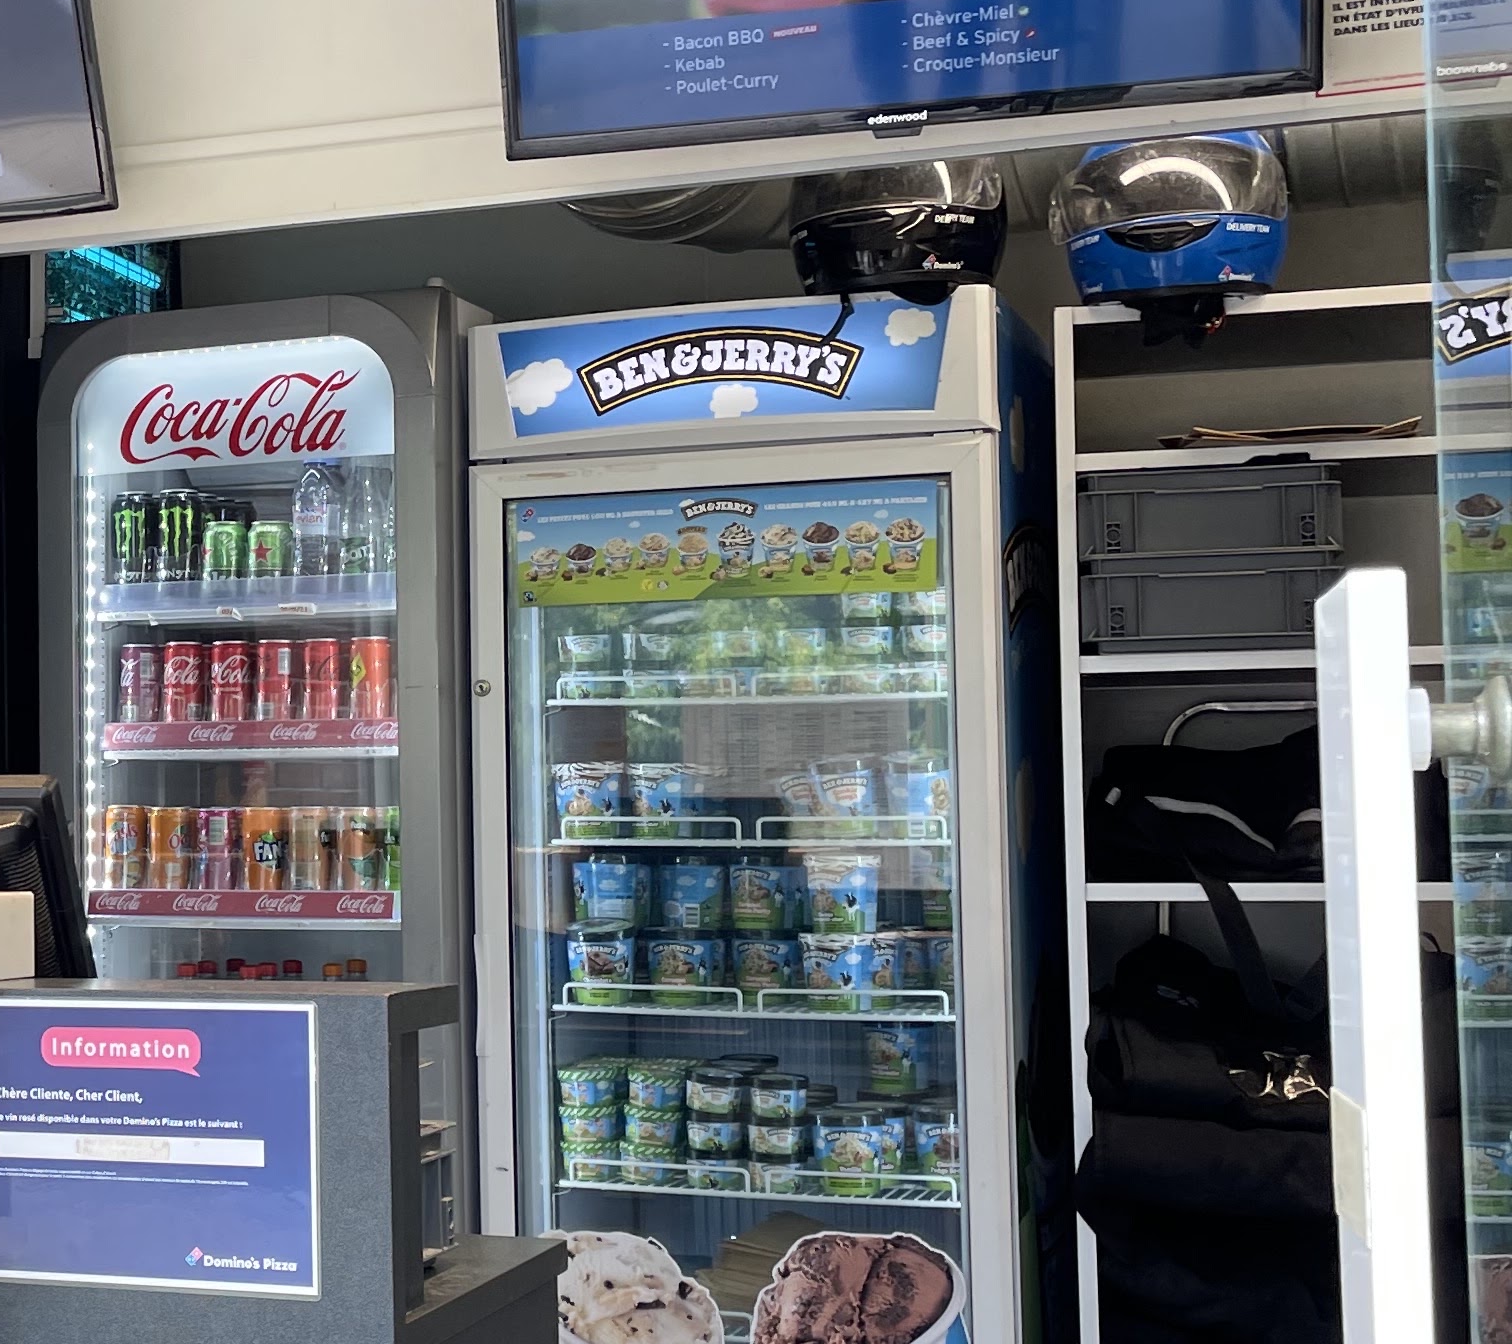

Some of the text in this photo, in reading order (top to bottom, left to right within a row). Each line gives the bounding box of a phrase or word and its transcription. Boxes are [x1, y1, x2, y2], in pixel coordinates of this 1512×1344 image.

[1346, 0, 1367, 10] EST
[912, 4, 1014, 29] Chèvre-Miel
[1333, 10, 1382, 24] EN ÉTAT
[1333, 22, 1390, 36] DANS LES
[674, 33, 724, 51] Bacon
[728, 29, 764, 47] BBQ
[913, 28, 1020, 51] Beef & Spicy
[675, 55, 725, 72] Kebab
[913, 46, 1059, 75] Croque-Monsieur
[676, 73, 779, 95] Poulet-Curry
[867, 110, 928, 126] edenwood
[120, 368, 361, 464] Coca-Cola
[52, 1037, 190, 1059] Information
[29, 1087, 74, 1102] Cliente,
[75, 1088, 103, 1102] Cher
[105, 1089, 143, 1104] Client,
[5, 1113, 18, 1122] vin
[19, 1113, 36, 1123] rosé
[37, 1113, 79, 1126] disponible
[80, 1114, 99, 1125] dans
[100, 1116, 122, 1126] votre
[123, 1115, 161, 1127] Domino's
[162, 1117, 183, 1127] Pizza
[184, 1119, 197, 1127] est
[198, 1118, 206, 1127] le
[207, 1119, 238, 1129] suivant
[203, 1254, 298, 1272] Domino's Pizza
